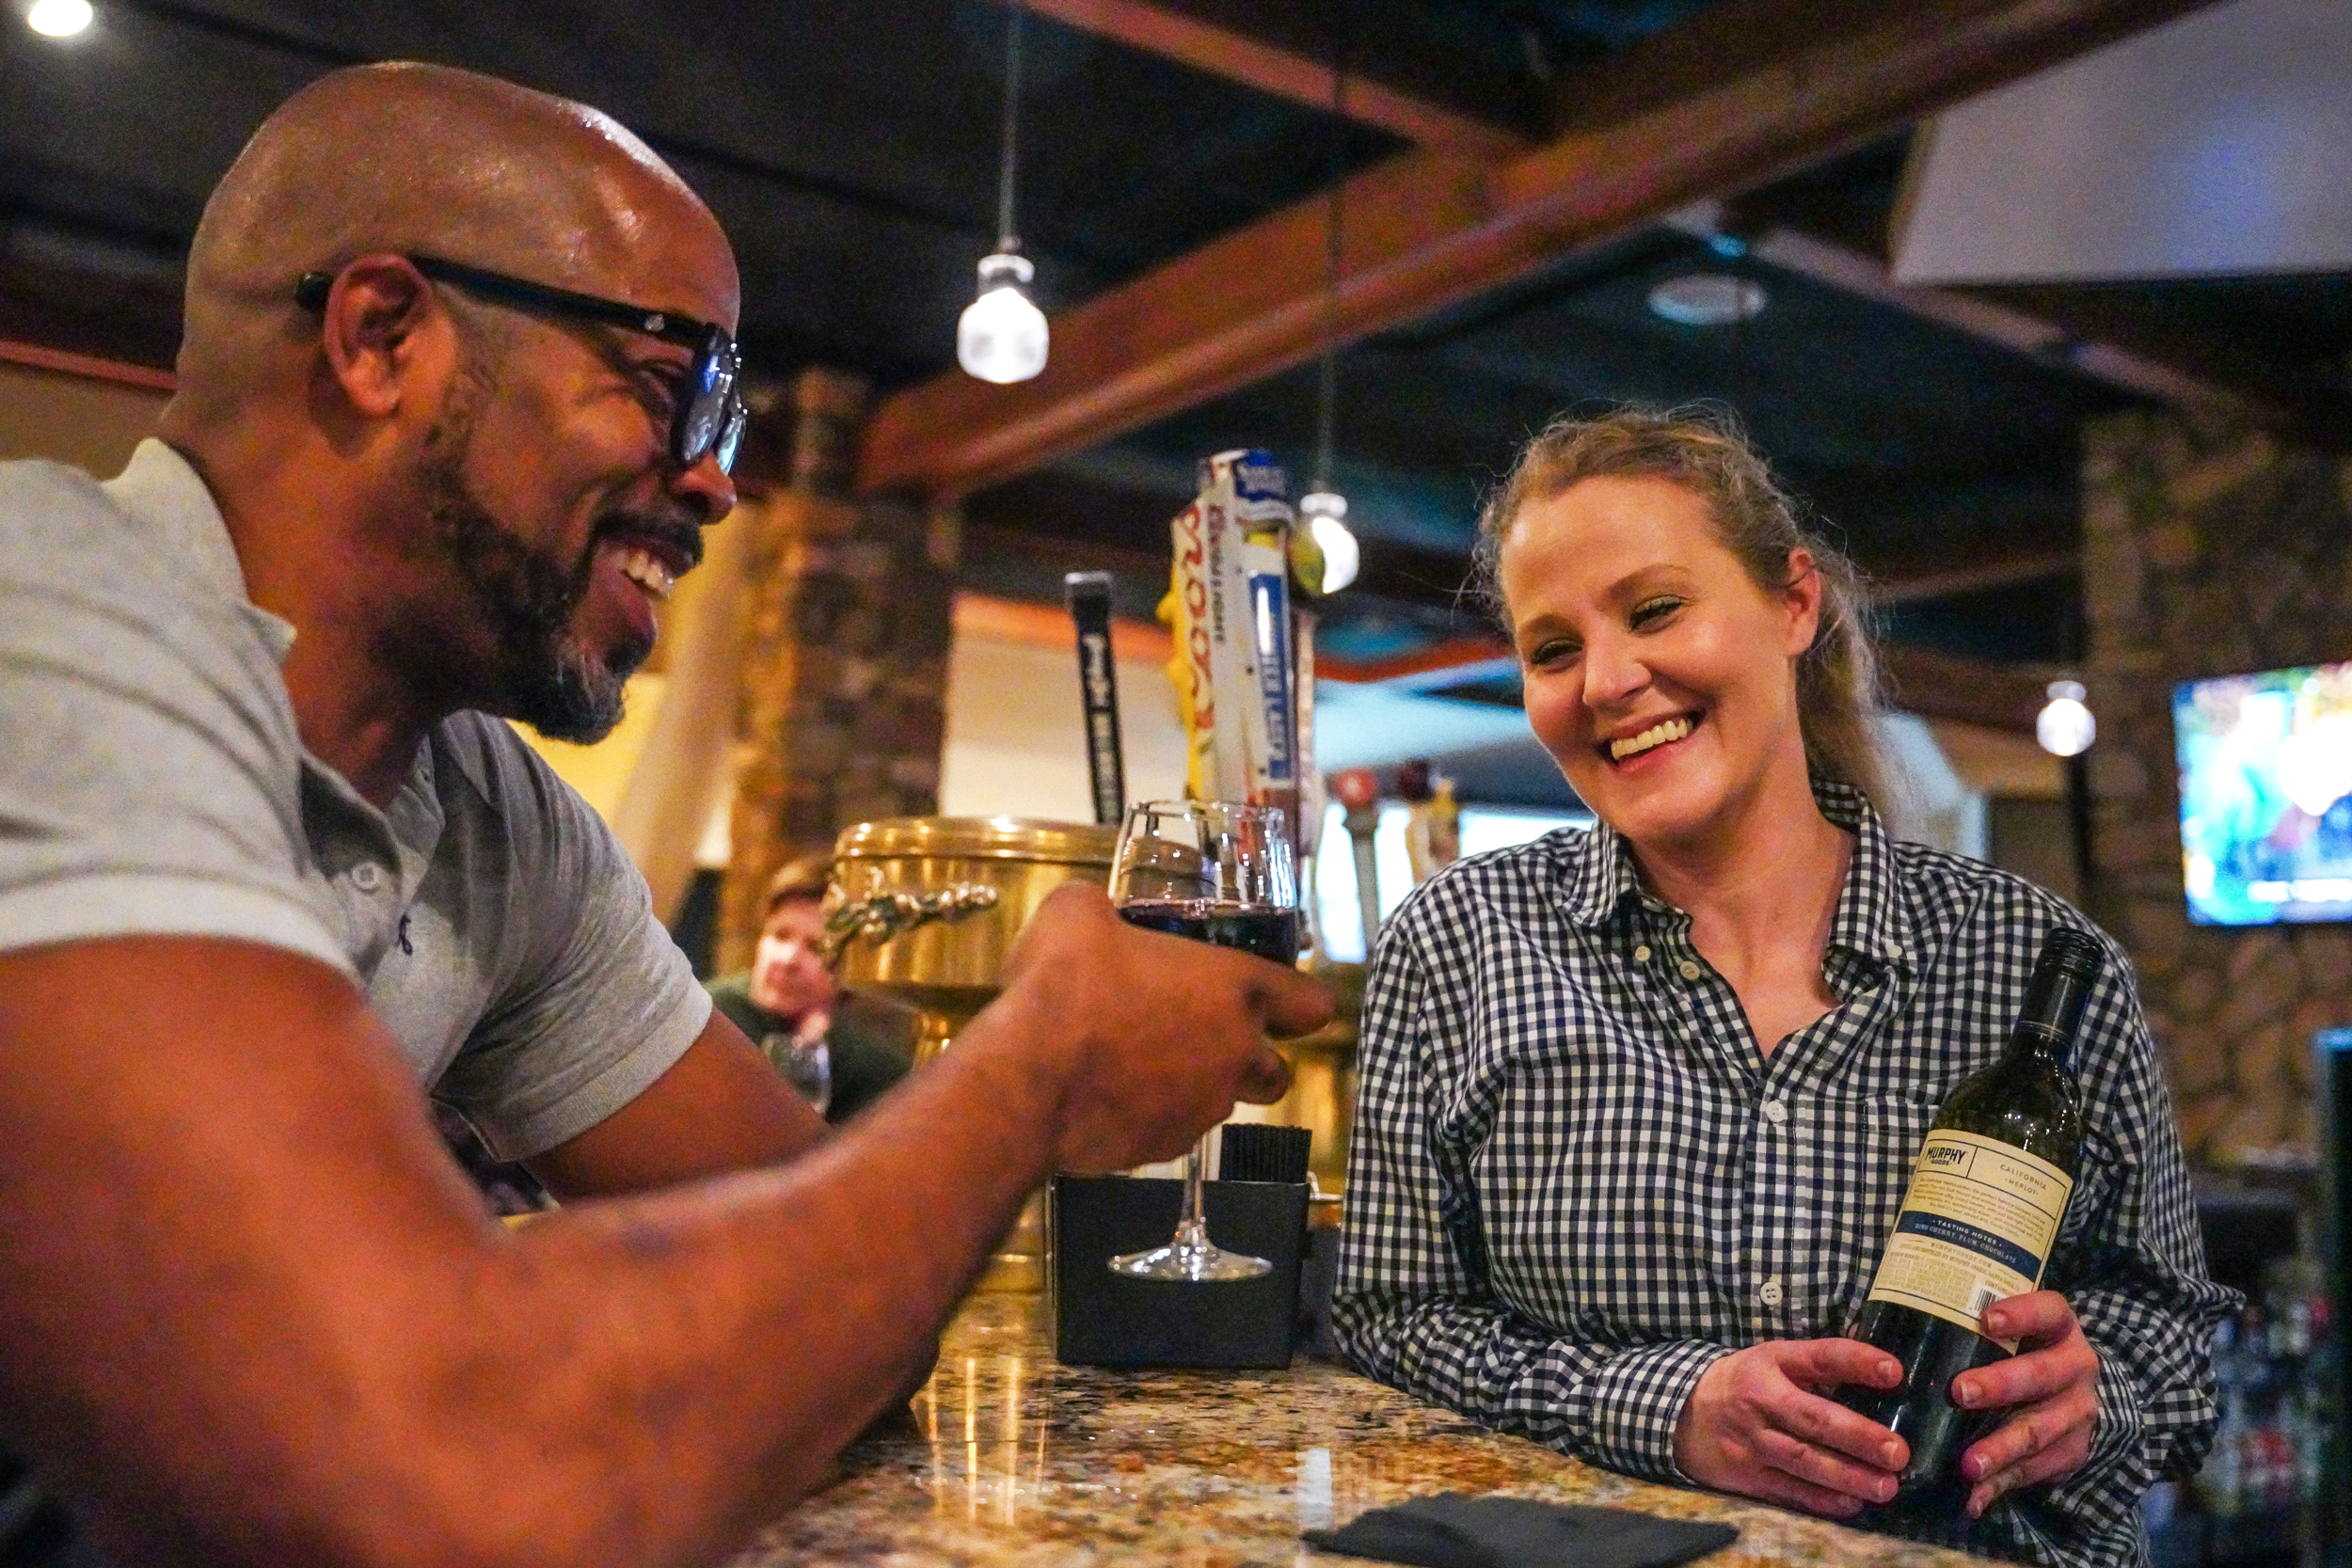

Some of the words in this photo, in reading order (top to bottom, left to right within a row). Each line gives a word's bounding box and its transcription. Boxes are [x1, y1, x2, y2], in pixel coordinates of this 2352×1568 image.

[1927, 1147, 1966, 1164] MURPHY
[2000, 1164, 2046, 1189] CALIFORNIA
[2008, 1179, 2036, 1195] MERLOT
[1936, 1219, 1969, 1234] TASTING
[1970, 1230, 1997, 1245] NOTES
